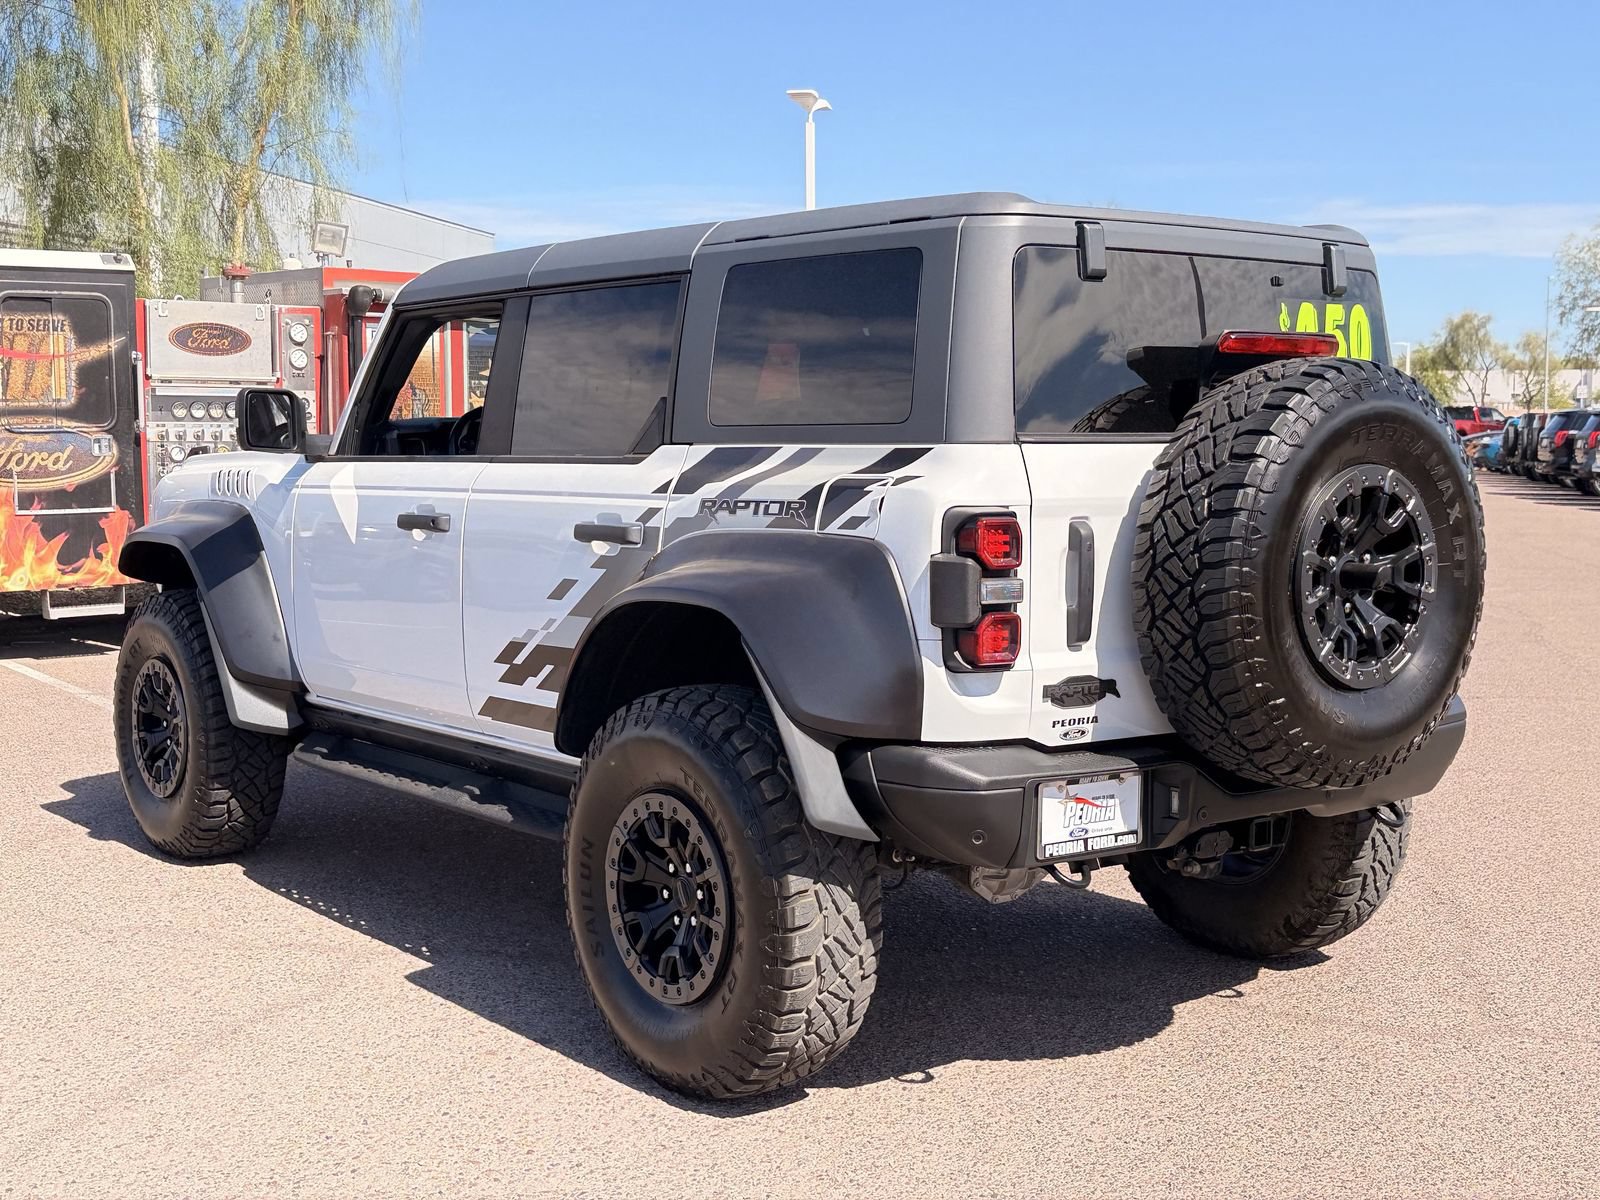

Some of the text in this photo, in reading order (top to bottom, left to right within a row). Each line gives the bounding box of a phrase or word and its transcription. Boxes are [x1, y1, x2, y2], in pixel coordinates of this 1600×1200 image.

[8, 318, 67, 331] TO SERVE
[187, 327, 233, 349] Ford
[698, 497, 808, 527] RAPTOR
[1051, 716, 1099, 729] PEORIA
[1063, 799, 1116, 828] PEORIA
[1045, 840, 1085, 858] PEORIA
[580, 836, 605, 957] SAILUN
